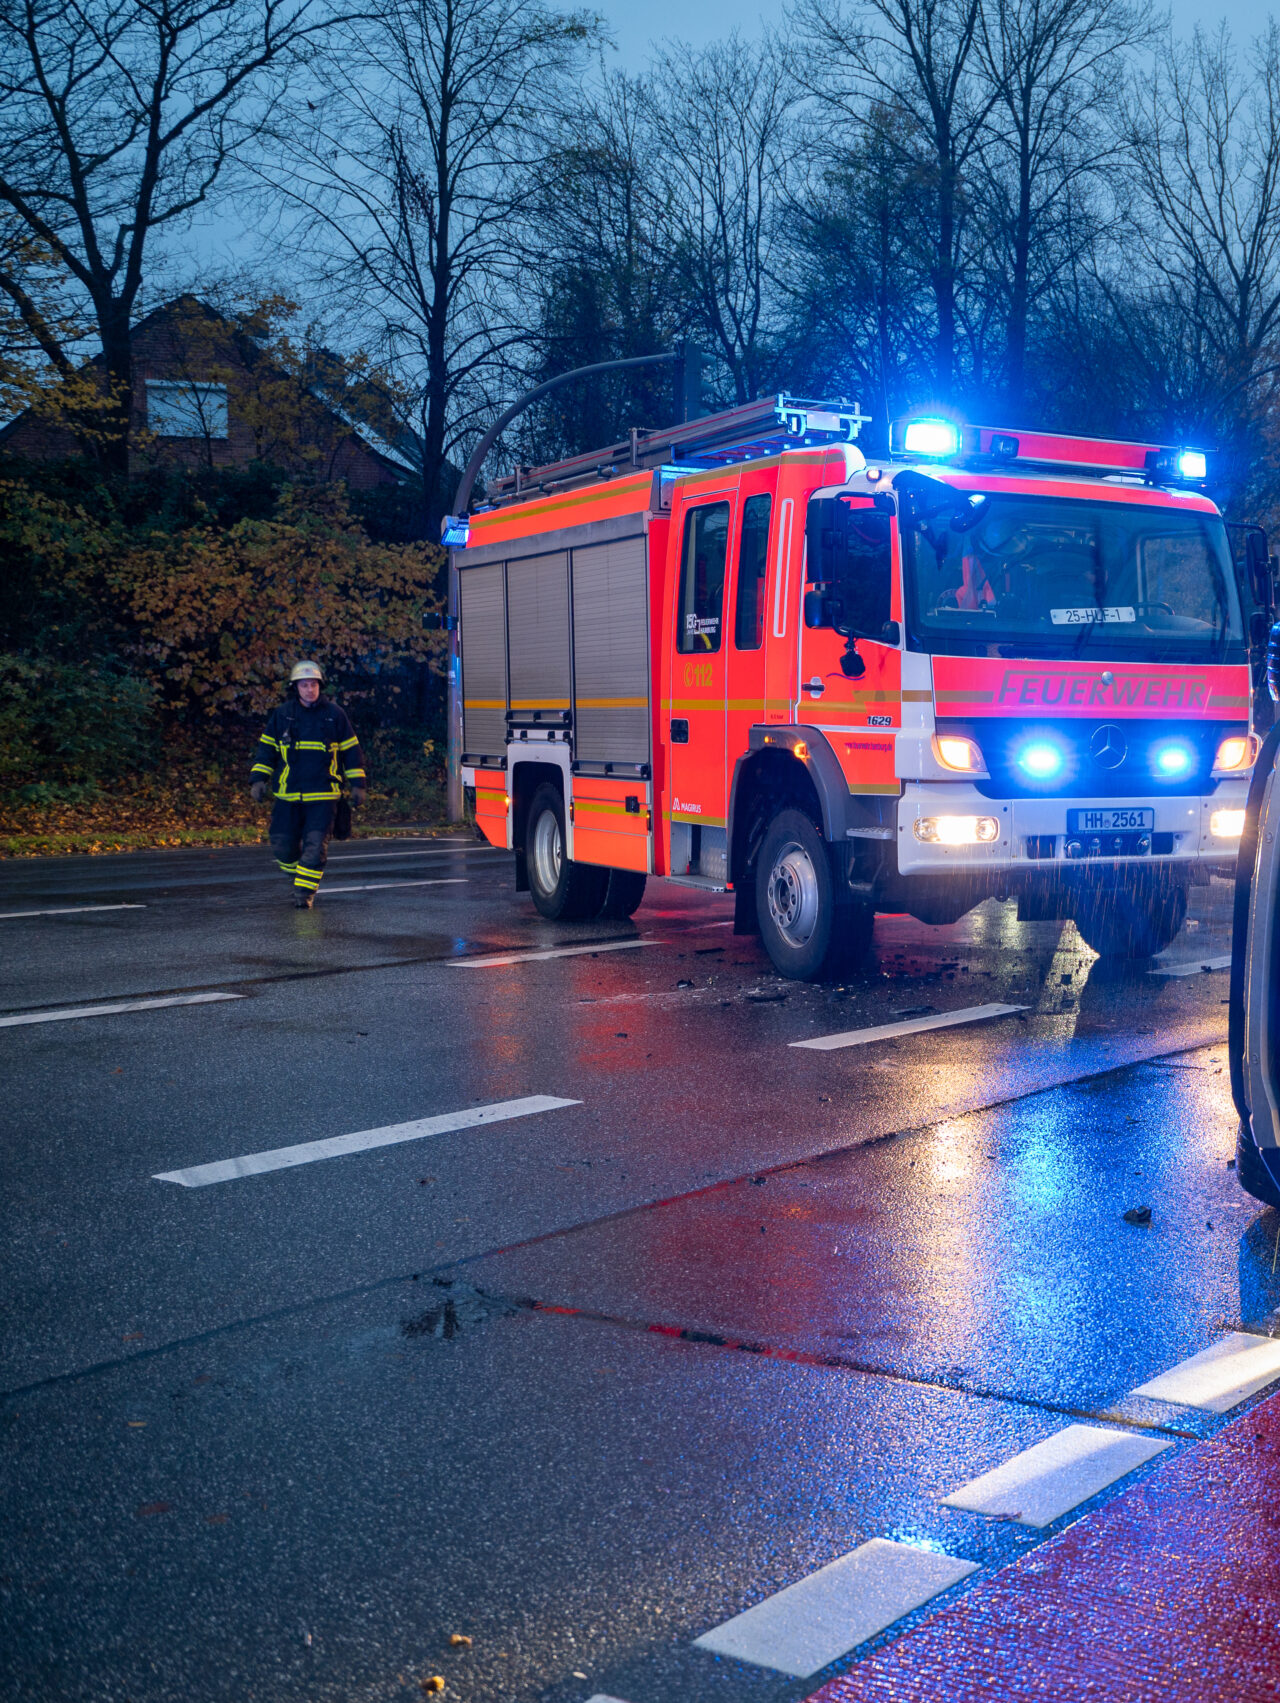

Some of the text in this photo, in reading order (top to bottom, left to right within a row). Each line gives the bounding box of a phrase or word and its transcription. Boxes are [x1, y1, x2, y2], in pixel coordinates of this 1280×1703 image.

[1066, 609, 1121, 623] 25-HLF-1
[694, 663, 713, 687] 112
[997, 670, 1207, 707] FEUERWEHR
[867, 715, 892, 726] 1629
[681, 802, 702, 813] MAGIRUS
[1084, 811, 1145, 828] HH 2561
